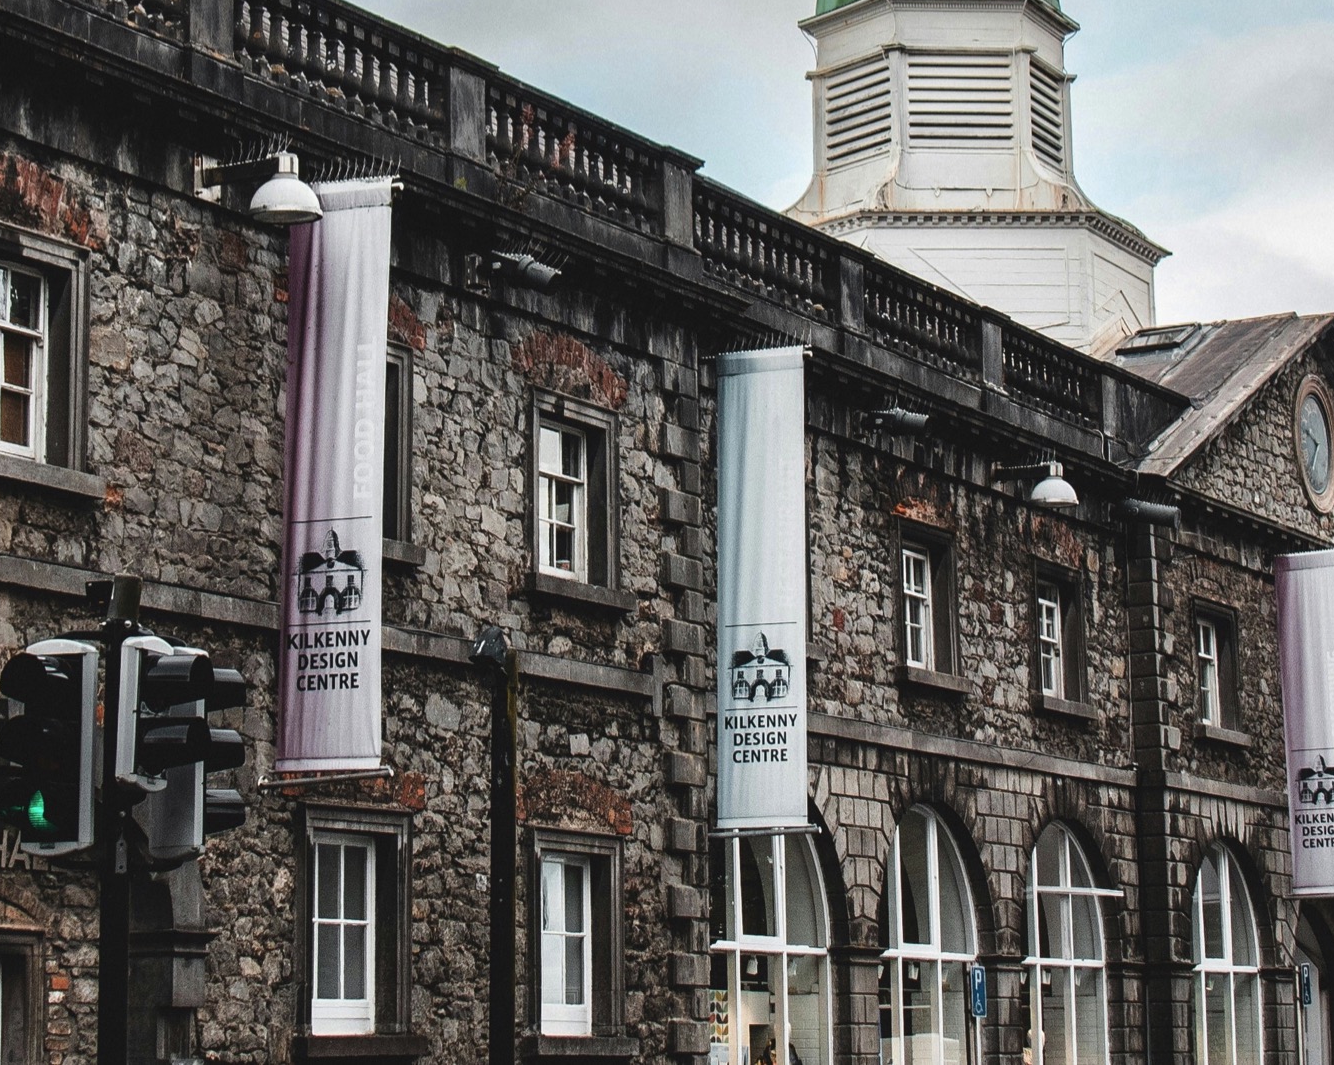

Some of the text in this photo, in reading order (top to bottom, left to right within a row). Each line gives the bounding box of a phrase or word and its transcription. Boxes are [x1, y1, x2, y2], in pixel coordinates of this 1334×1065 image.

[353, 336, 378, 500] FOOD HALL
[287, 629, 370, 650] KILKENNY
[298, 651, 358, 671] DESIGN
[296, 672, 359, 692] CENTRE
[725, 713, 797, 730] KILKENNY
[733, 731, 787, 746] DESIGN
[732, 748, 788, 763] CENTRE
[974, 969, 982, 991] P
[1303, 966, 1309, 984] P
